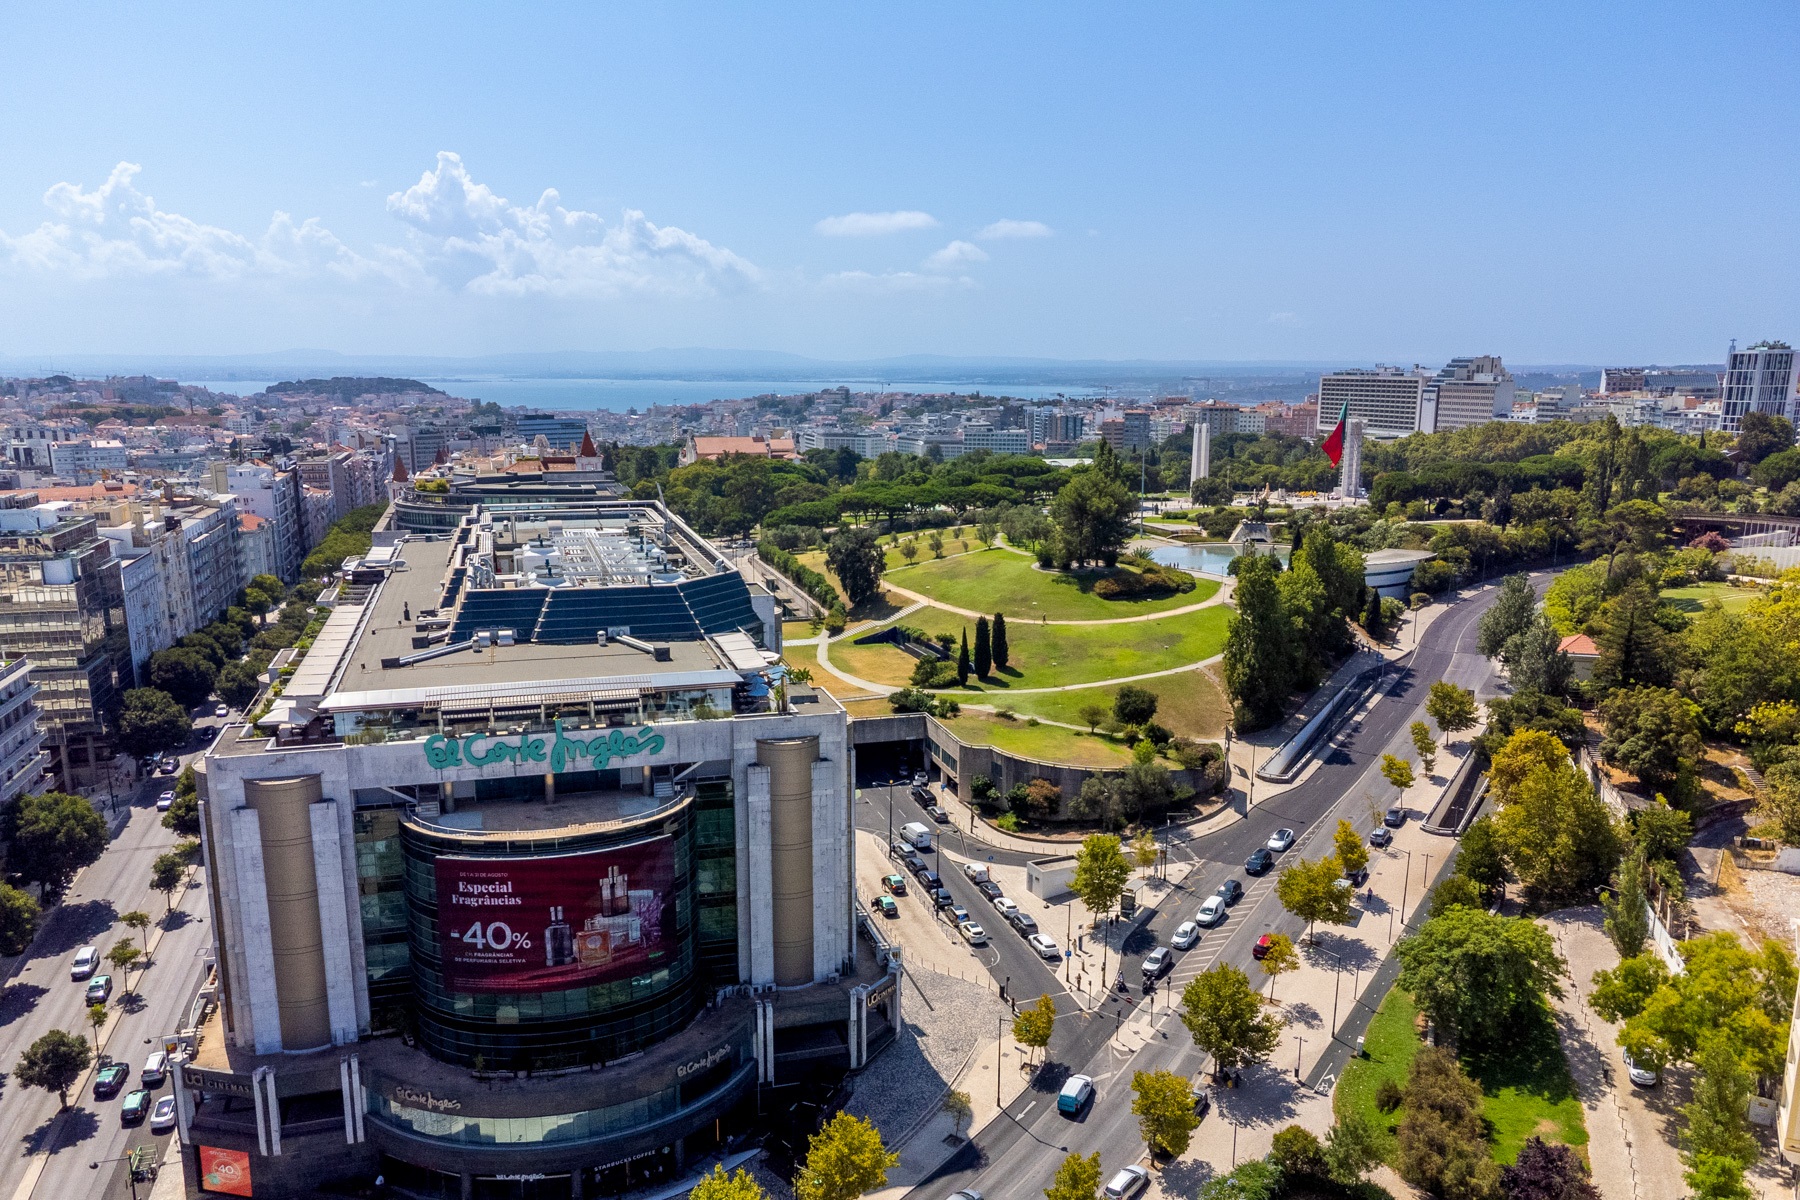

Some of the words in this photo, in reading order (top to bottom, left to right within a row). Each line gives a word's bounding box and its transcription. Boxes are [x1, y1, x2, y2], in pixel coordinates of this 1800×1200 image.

[424, 734, 462, 769] El
[463, 733, 546, 766] Corte
[551, 719, 665, 773] Inglés
[458, 881, 512, 895] Especial
[452, 894, 522, 907] Fragrâncias
[450, 921, 531, 950] -40%
[677, 1065, 687, 1077] El
[687, 1058, 707, 1073] Corte
[207, 1080, 250, 1092] CINEMAS
[405, 1090, 427, 1104] Corte
[594, 1157, 632, 1172] STARBUCKS
[632, 1150, 656, 1160] COFFEE
